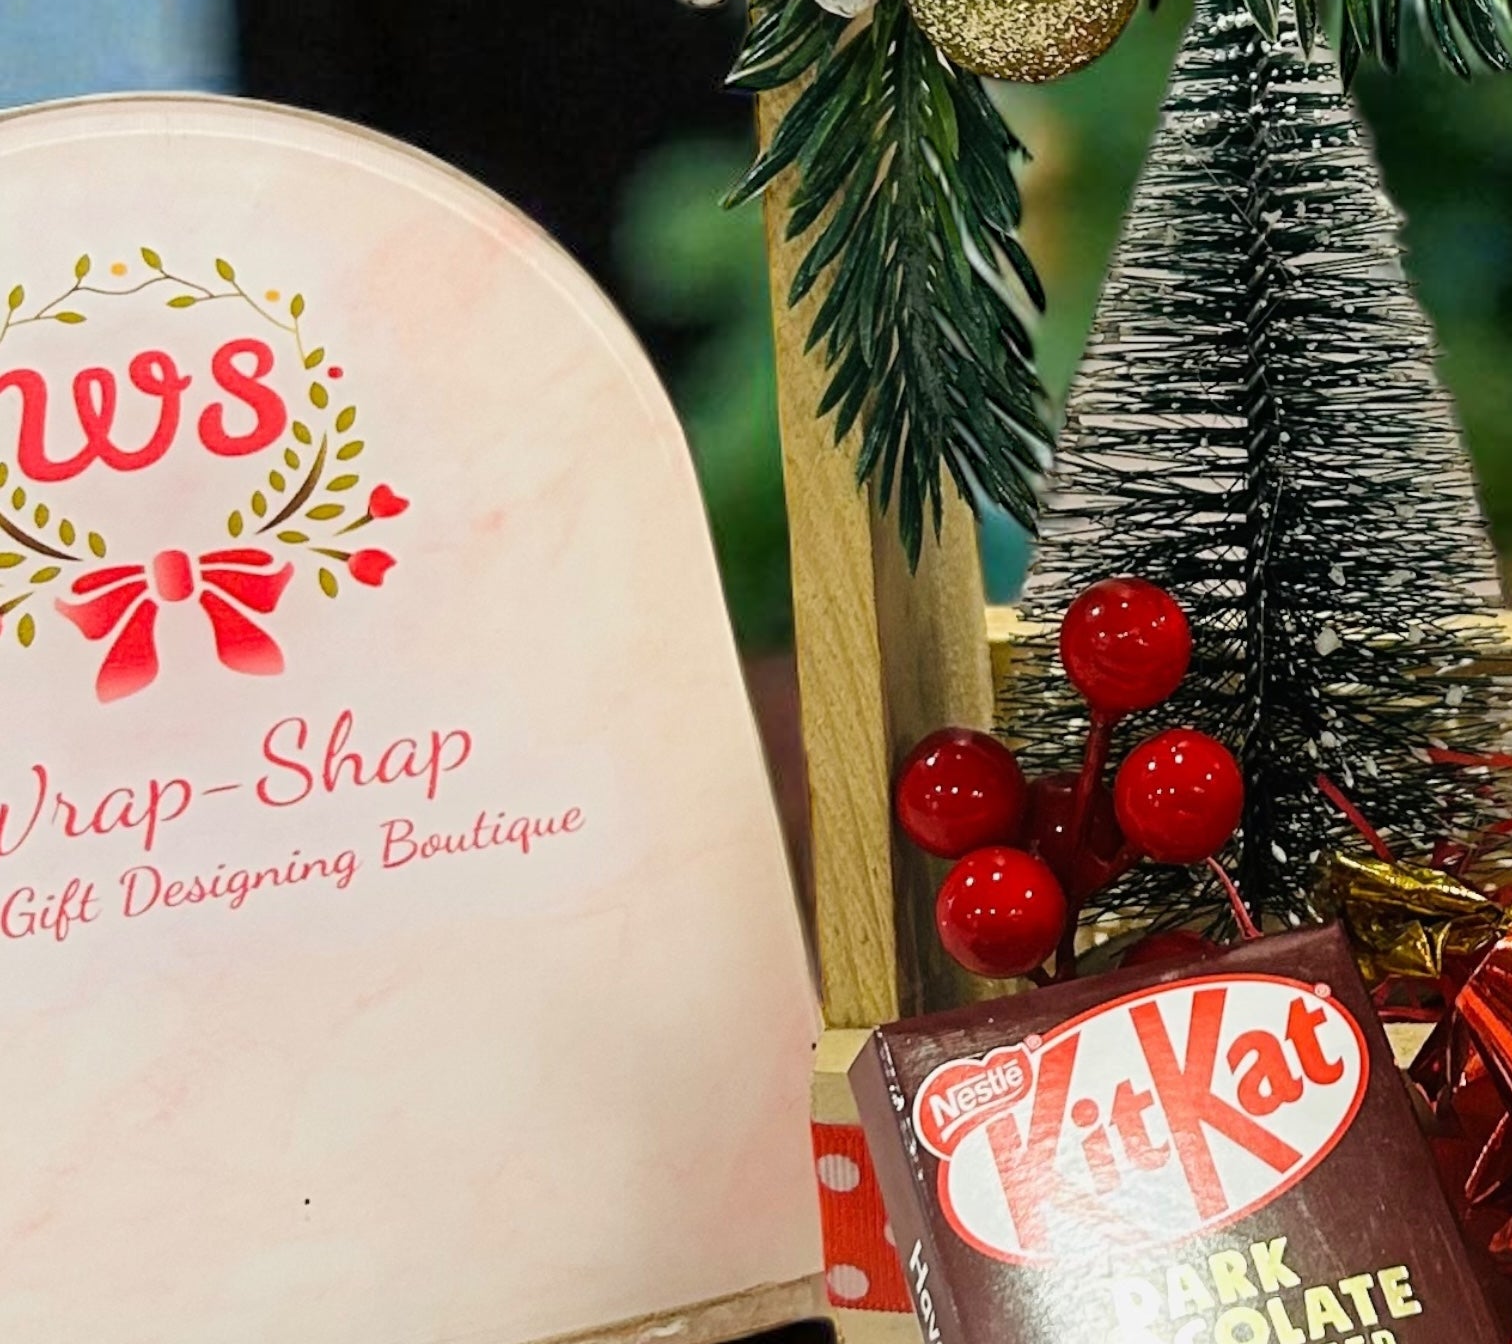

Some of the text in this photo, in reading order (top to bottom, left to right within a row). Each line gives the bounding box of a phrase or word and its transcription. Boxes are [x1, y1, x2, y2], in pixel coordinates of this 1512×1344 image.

[0, 805, 586, 943] Gift Designing Boutique
[985, 987, 1346, 1254] KitKat
[1110, 1236, 1302, 1327] DARK
